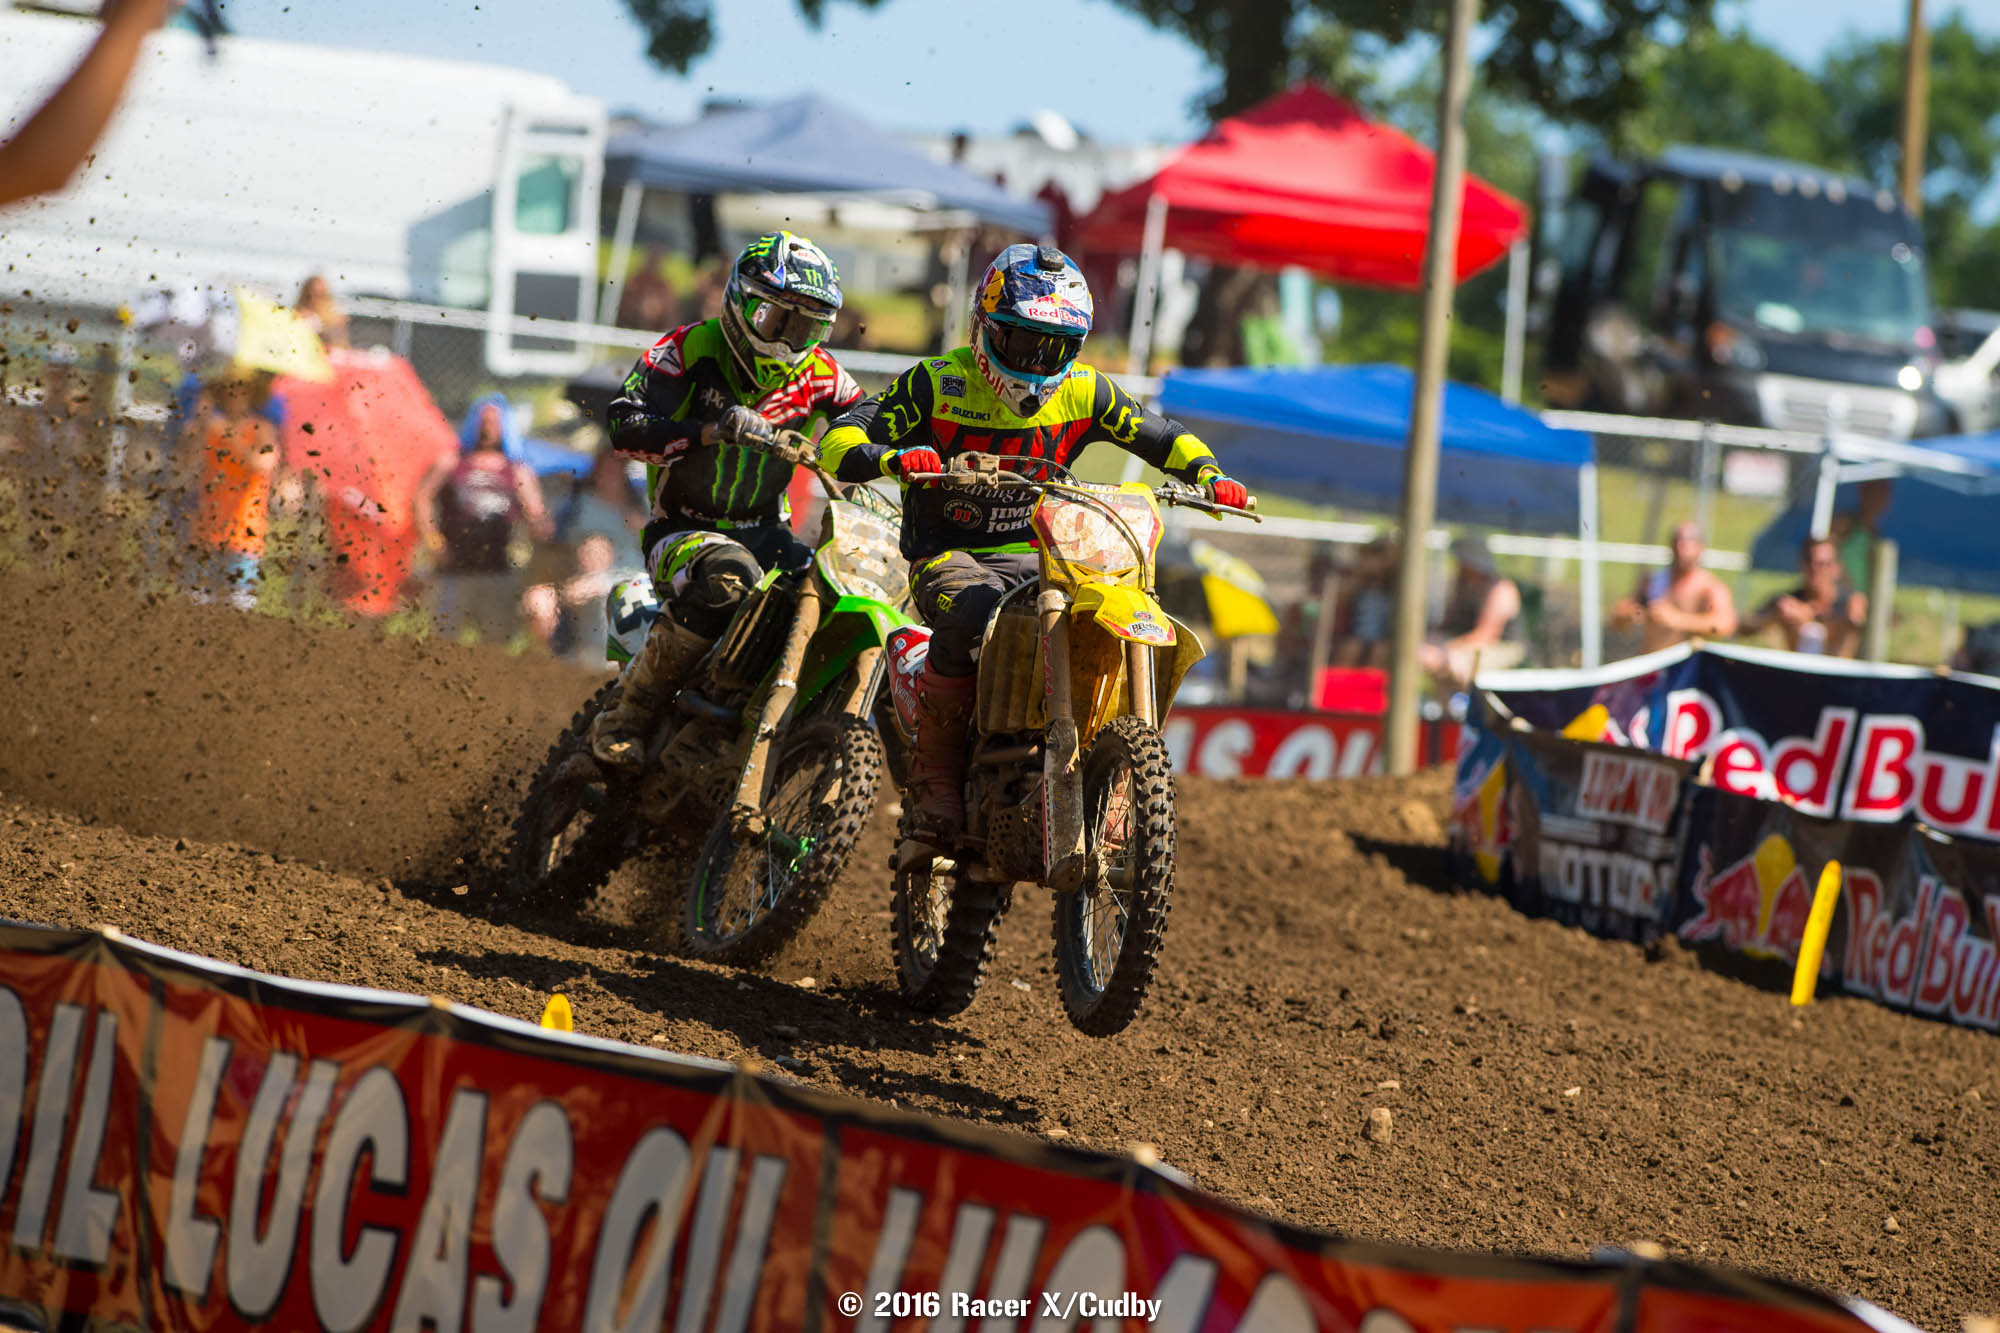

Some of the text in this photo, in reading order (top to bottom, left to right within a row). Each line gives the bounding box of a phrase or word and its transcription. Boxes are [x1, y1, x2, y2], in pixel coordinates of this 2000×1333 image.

[1028, 307, 1087, 327] Red Bull
[951, 406, 991, 421] SUZUKI
[1663, 689, 1855, 816] Red
[1842, 866, 1937, 1004] Red
[163, 1033, 573, 1333] LUCAS
